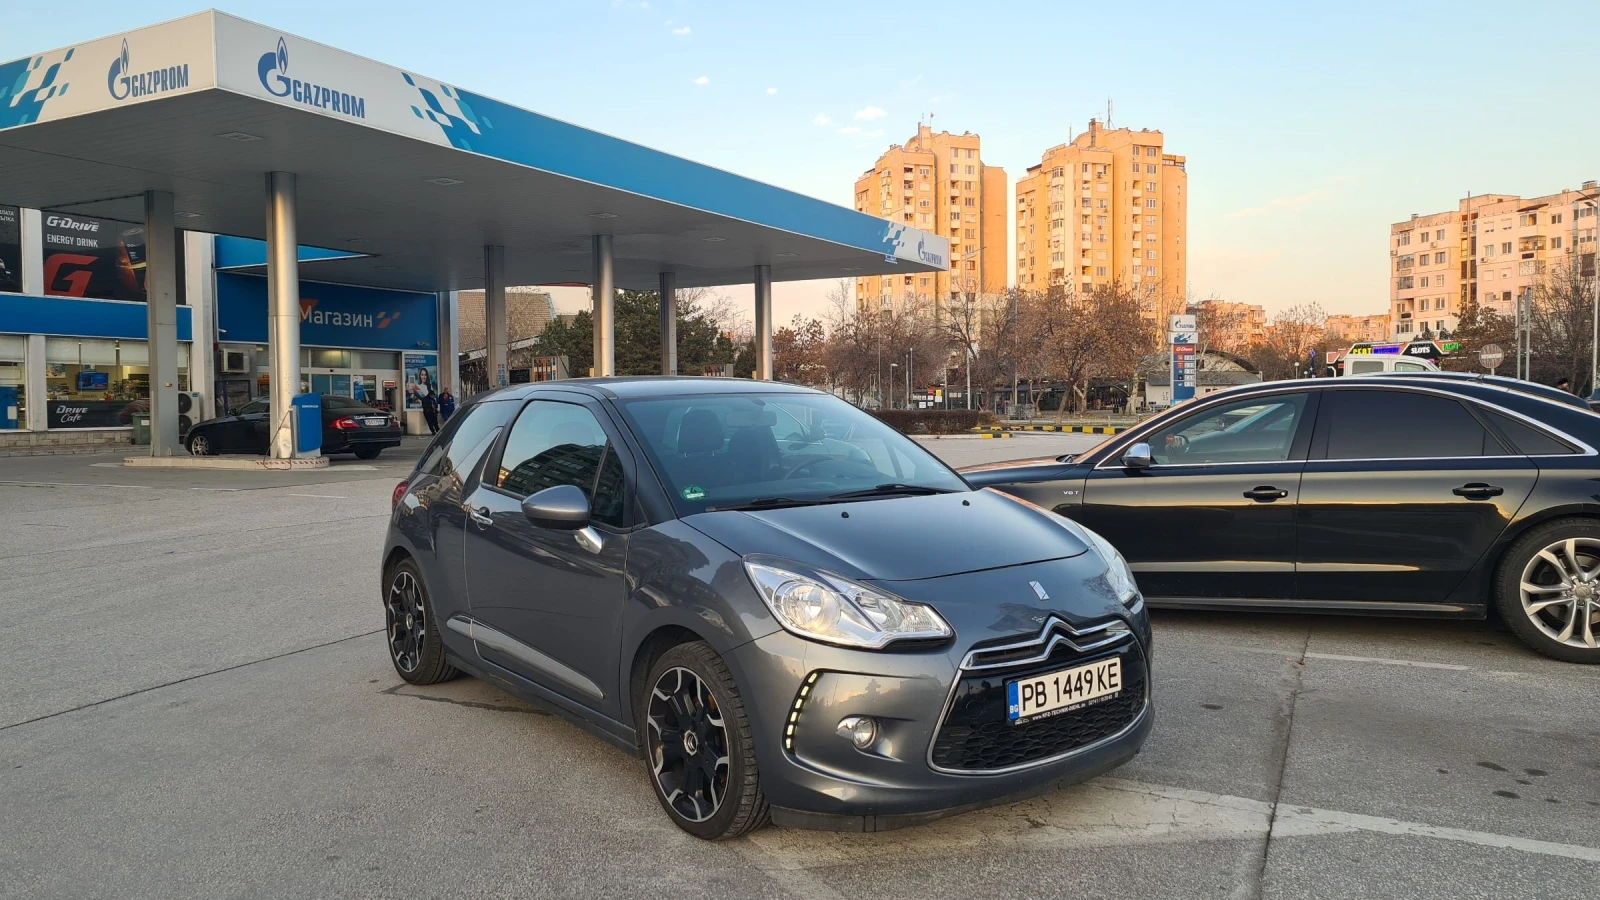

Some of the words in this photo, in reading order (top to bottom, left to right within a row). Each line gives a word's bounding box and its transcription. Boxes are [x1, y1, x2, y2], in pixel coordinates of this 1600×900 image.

[132, 64, 188, 97] GAZPROM
[293, 79, 365, 118] GAZPROM
[47, 234, 74, 245] ENERGY
[76, 237, 98, 248] DRINK
[299, 305, 373, 328] Магазин
[56, 405, 88, 415] DRIVE
[1022, 681, 1047, 711] PB
[1053, 669, 1093, 703] 1449
[1097, 662, 1119, 692] KE
[1009, 705, 1019, 714] BG
